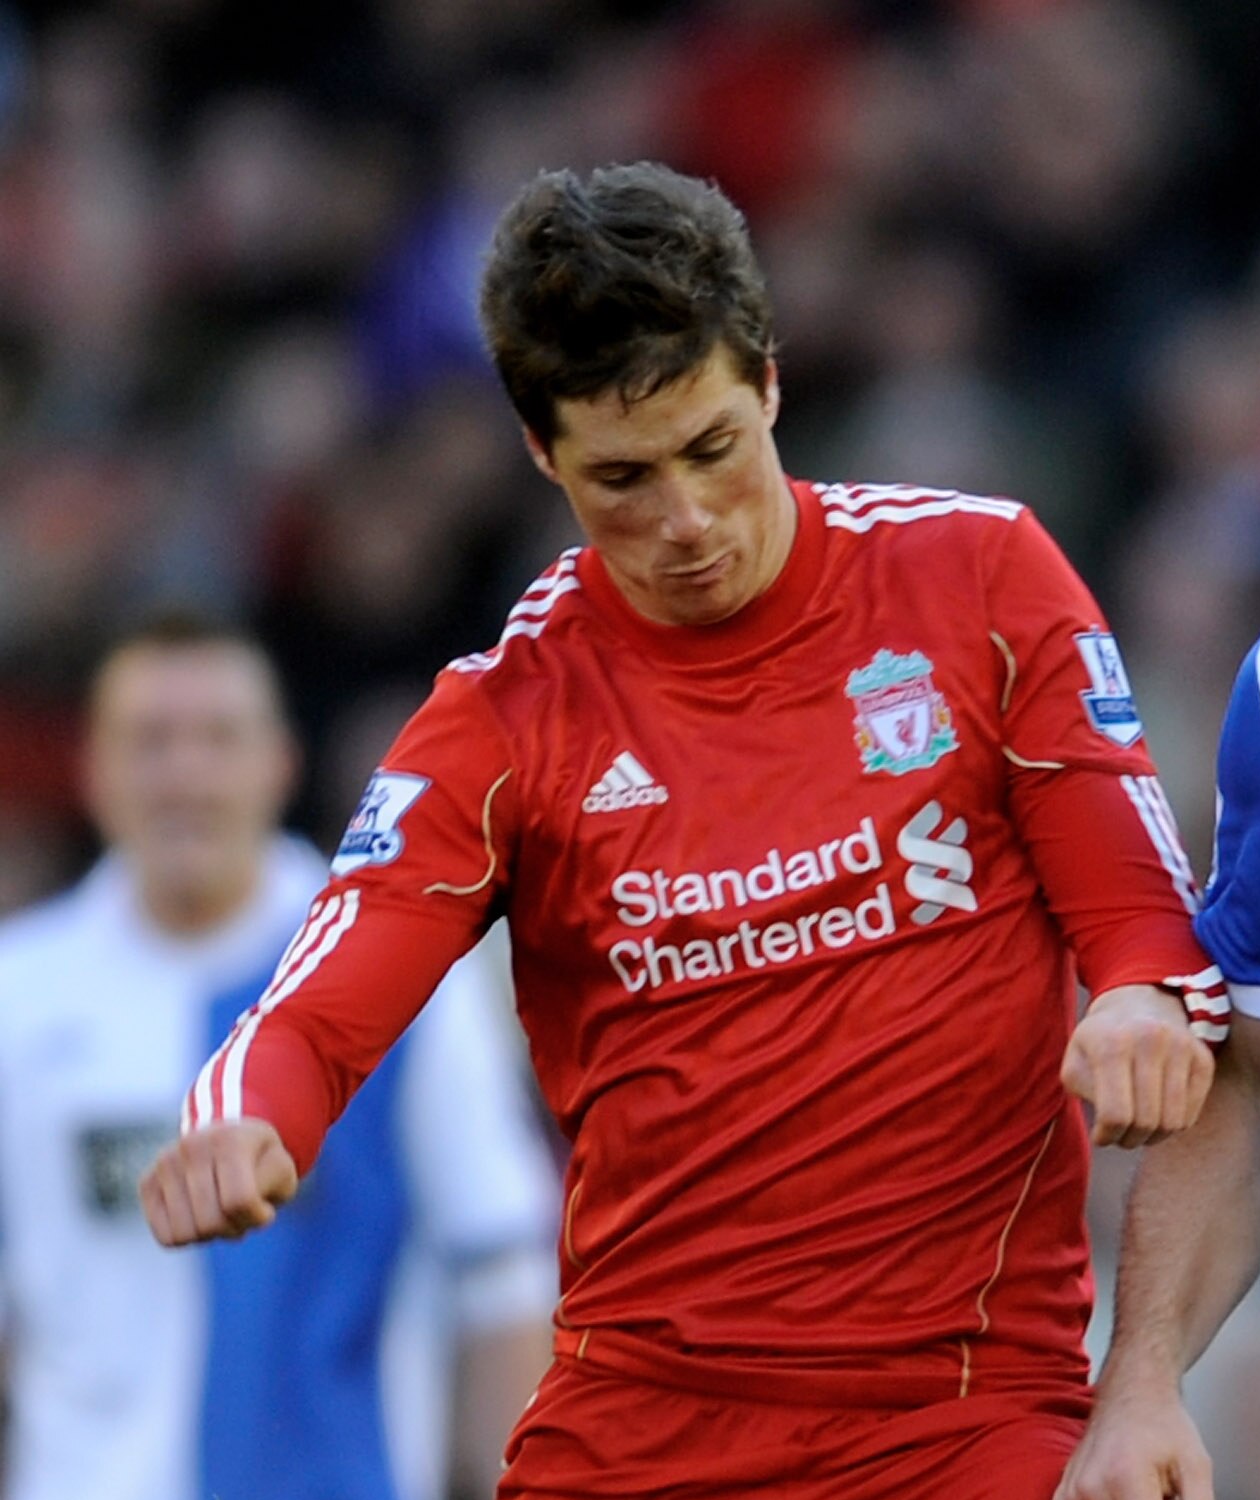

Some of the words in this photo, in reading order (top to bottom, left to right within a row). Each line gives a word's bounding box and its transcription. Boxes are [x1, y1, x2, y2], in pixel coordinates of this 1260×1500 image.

[582, 785, 669, 814] adidas
[611, 816, 882, 927] Standard
[608, 883, 896, 993] Chartered
